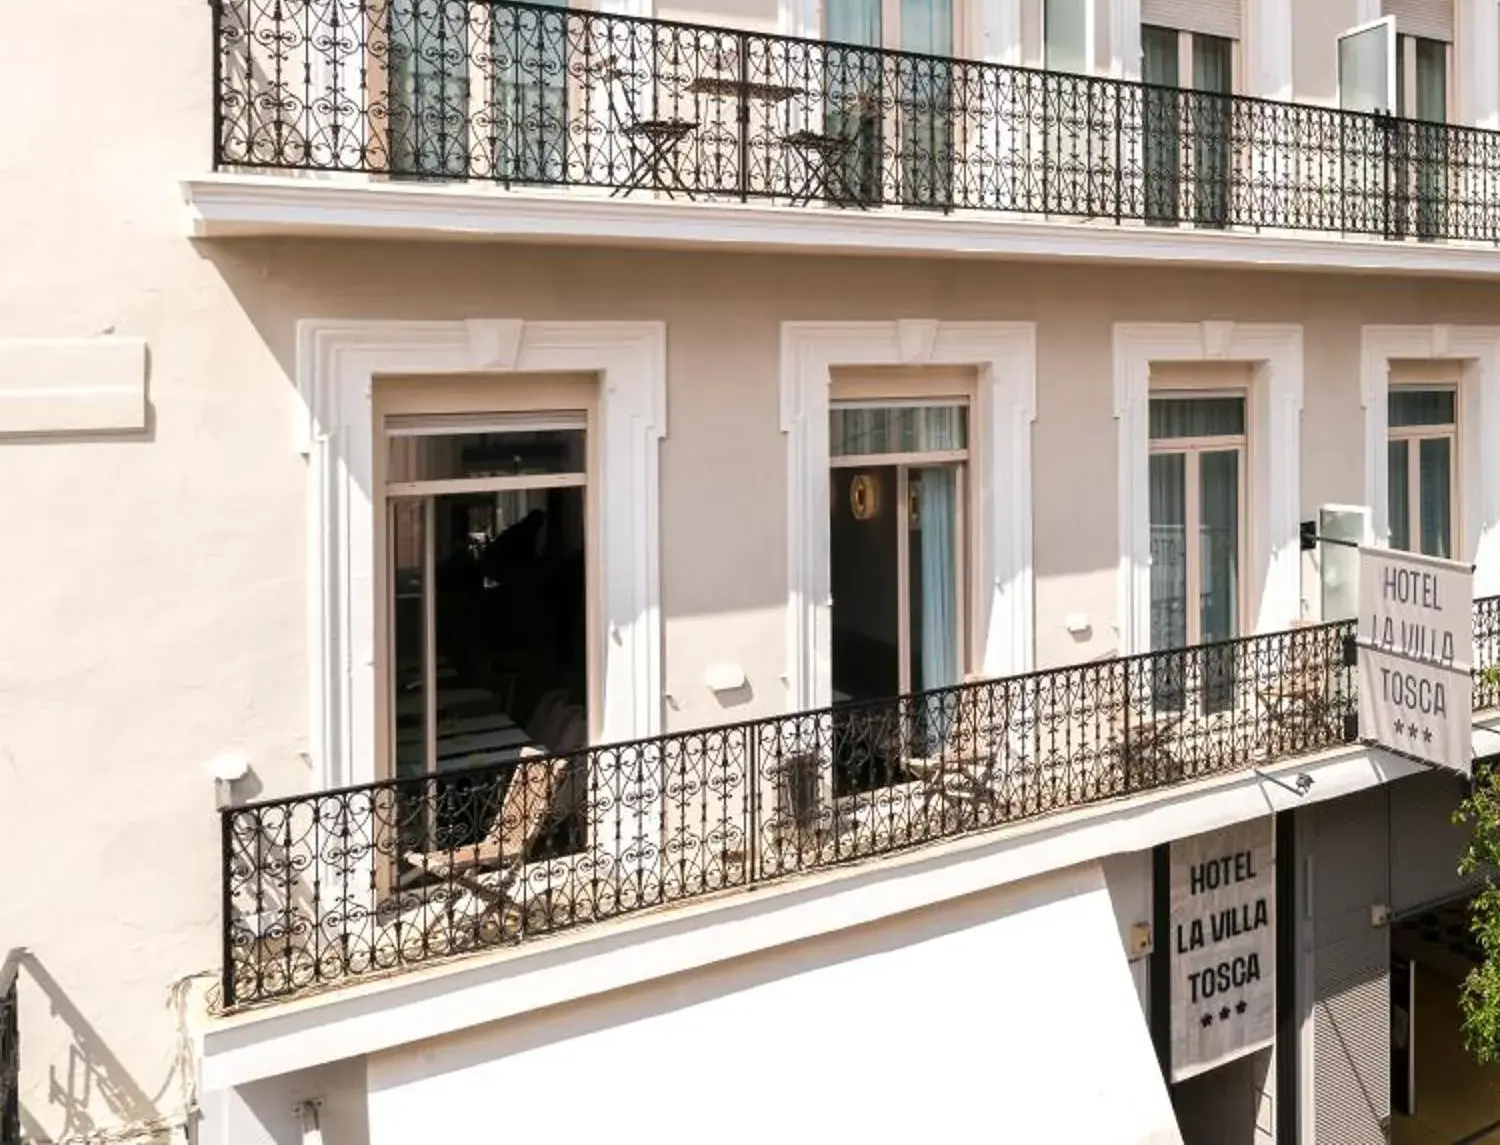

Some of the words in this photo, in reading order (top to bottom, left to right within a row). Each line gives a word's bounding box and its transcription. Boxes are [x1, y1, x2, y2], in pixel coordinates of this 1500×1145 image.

[1383, 566, 1443, 611] HOTEL
[1371, 614, 1395, 652] LA
[1401, 619, 1455, 669] VILLA
[1380, 667, 1447, 719] TOSCA
[1190, 850, 1257, 896] HOTEL
[1177, 918, 1205, 954] LA
[1210, 897, 1268, 943] VILLA
[1187, 953, 1260, 1004] TOSCA
